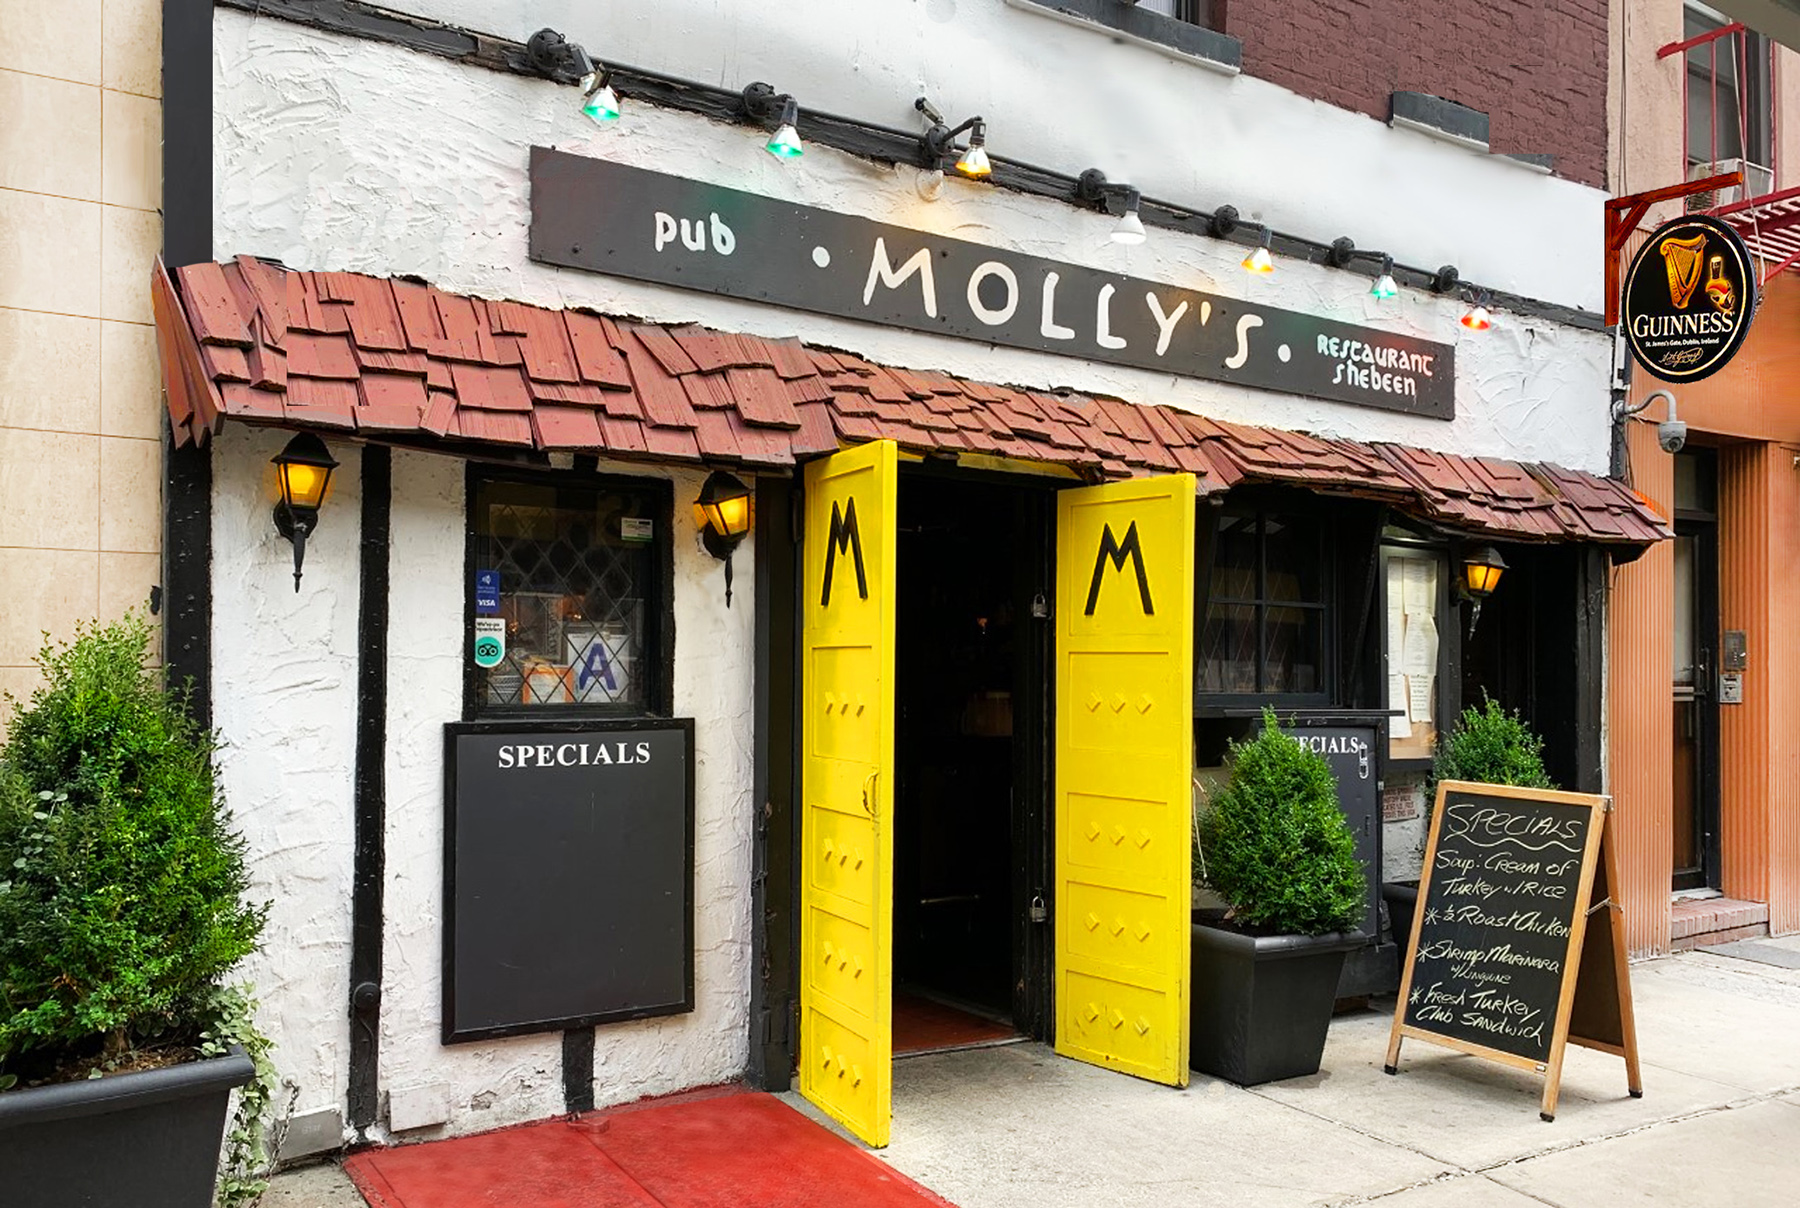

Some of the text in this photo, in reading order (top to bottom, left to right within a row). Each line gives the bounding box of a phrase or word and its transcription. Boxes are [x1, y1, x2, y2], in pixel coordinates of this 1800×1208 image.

[863, 237, 1263, 369] MOLLY'S
[1633, 311, 1734, 338] GUINNESS
[821, 496, 868, 607] M
[1084, 520, 1154, 616] M
[478, 599, 496, 607] VISA
[579, 643, 618, 690] A
[498, 742, 651, 768] SPECIALS
[1545, 859, 1580, 877] of
